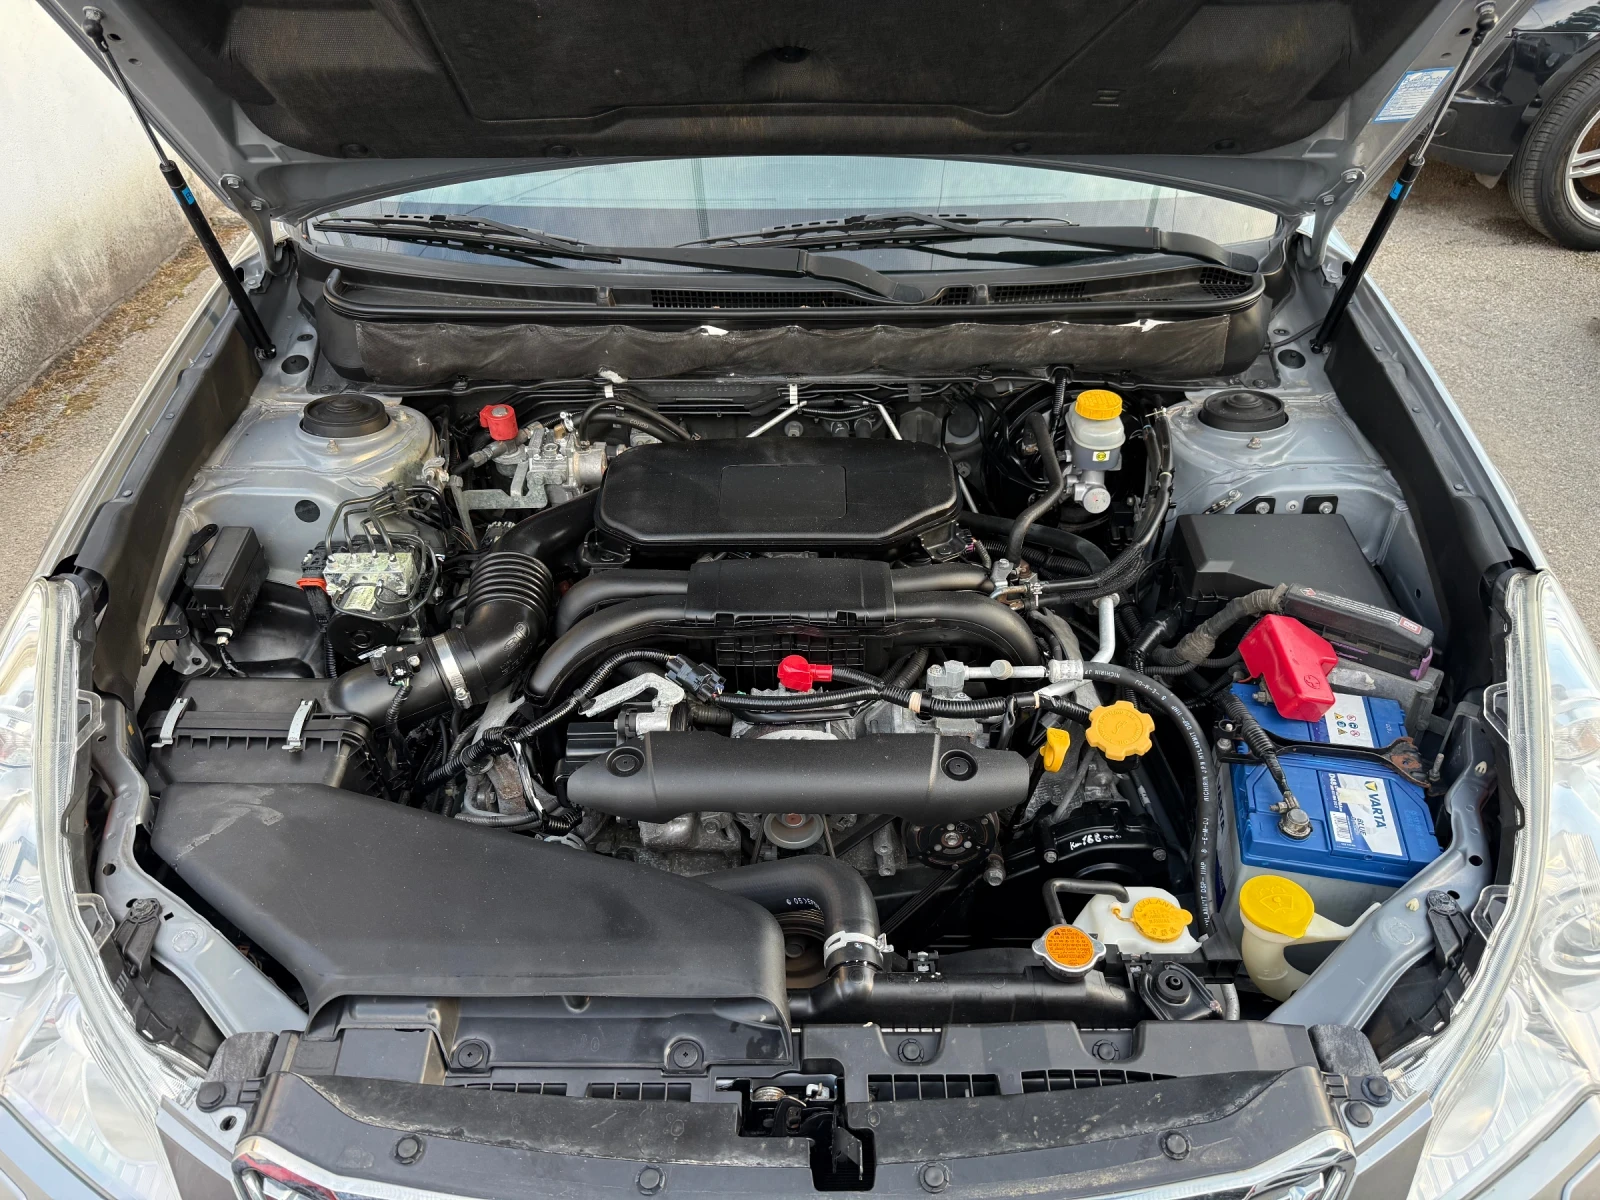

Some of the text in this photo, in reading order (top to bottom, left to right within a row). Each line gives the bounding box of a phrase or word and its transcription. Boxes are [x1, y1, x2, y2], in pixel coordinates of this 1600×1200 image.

[1094, 669, 1120, 679] NICHIRIN
[1368, 793, 1387, 828] VARTA
[1357, 818, 1367, 836] BLUE
[1135, 899, 1176, 913] COOLANT
